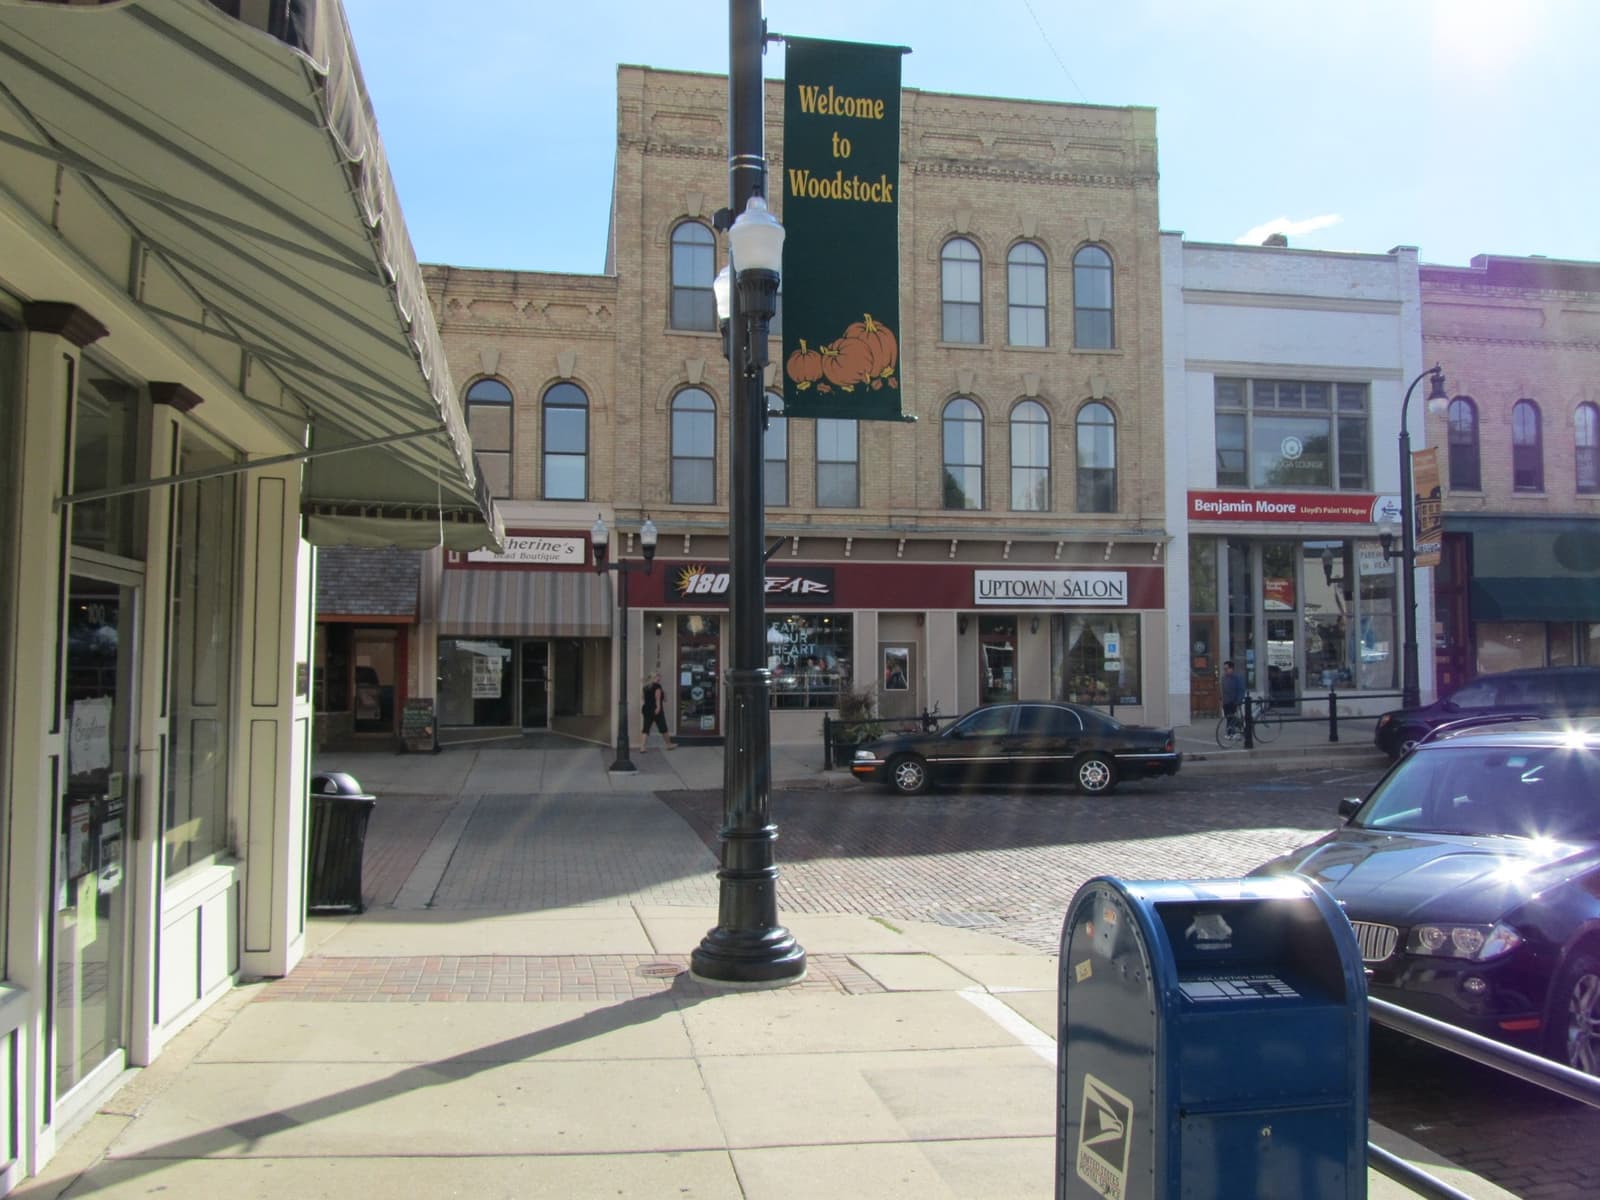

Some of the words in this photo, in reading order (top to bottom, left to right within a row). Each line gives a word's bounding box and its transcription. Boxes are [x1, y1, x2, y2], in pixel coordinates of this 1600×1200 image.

[798, 84, 885, 120] Welcome
[832, 131, 851, 158] to
[789, 168, 893, 203] Woodstock
[1194, 498, 1253, 515] Benjamin
[1256, 500, 1296, 513] Moore
[504, 538, 576, 554] herine's
[520, 552, 561, 562] Boutique
[686, 573, 731, 594] 180
[763, 576, 831, 594] EAR
[979, 579, 1056, 597] UPTOWN
[1063, 578, 1123, 597] SALON
[772, 622, 797, 632] EAT
[773, 630, 808, 643] OUR
[772, 643, 816, 655] HEART
[773, 654, 799, 666] OUT
[1080, 1151, 1100, 1169] UNITED
[1100, 1164, 1120, 1185] STATES
